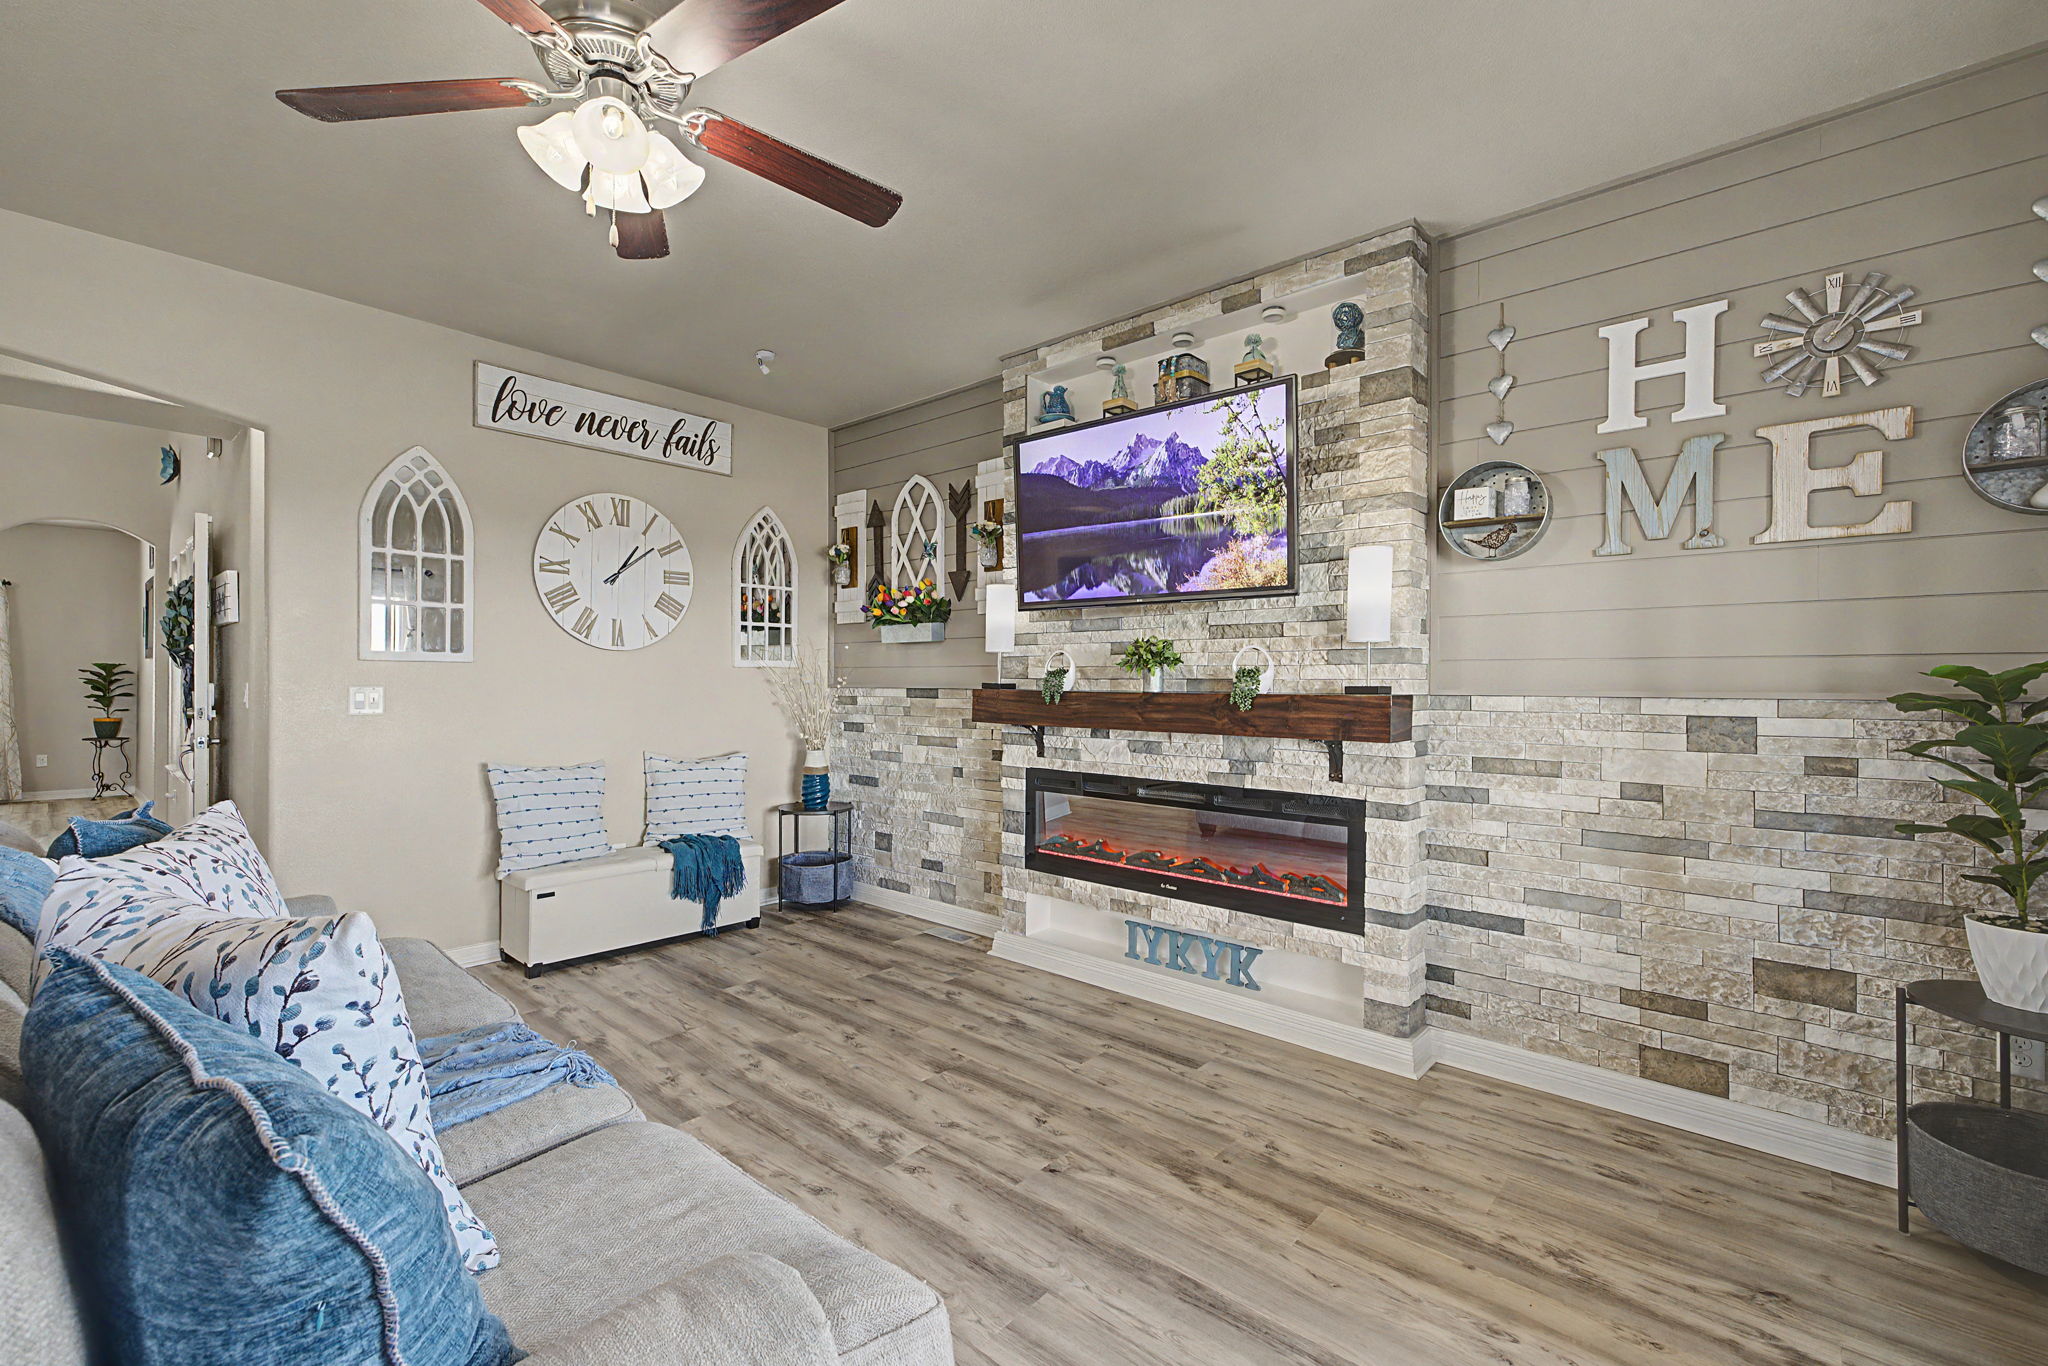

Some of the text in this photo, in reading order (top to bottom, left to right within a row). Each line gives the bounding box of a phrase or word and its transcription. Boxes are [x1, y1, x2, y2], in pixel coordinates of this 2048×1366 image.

[1598, 299, 1729, 434] H
[491, 376, 721, 466] love never fails
[575, 500, 603, 533] XI
[609, 496, 631, 528] XII
[548, 521, 581, 549] X
[539, 555, 571, 576] IX
[1124, 919, 1264, 991] IYKYK
